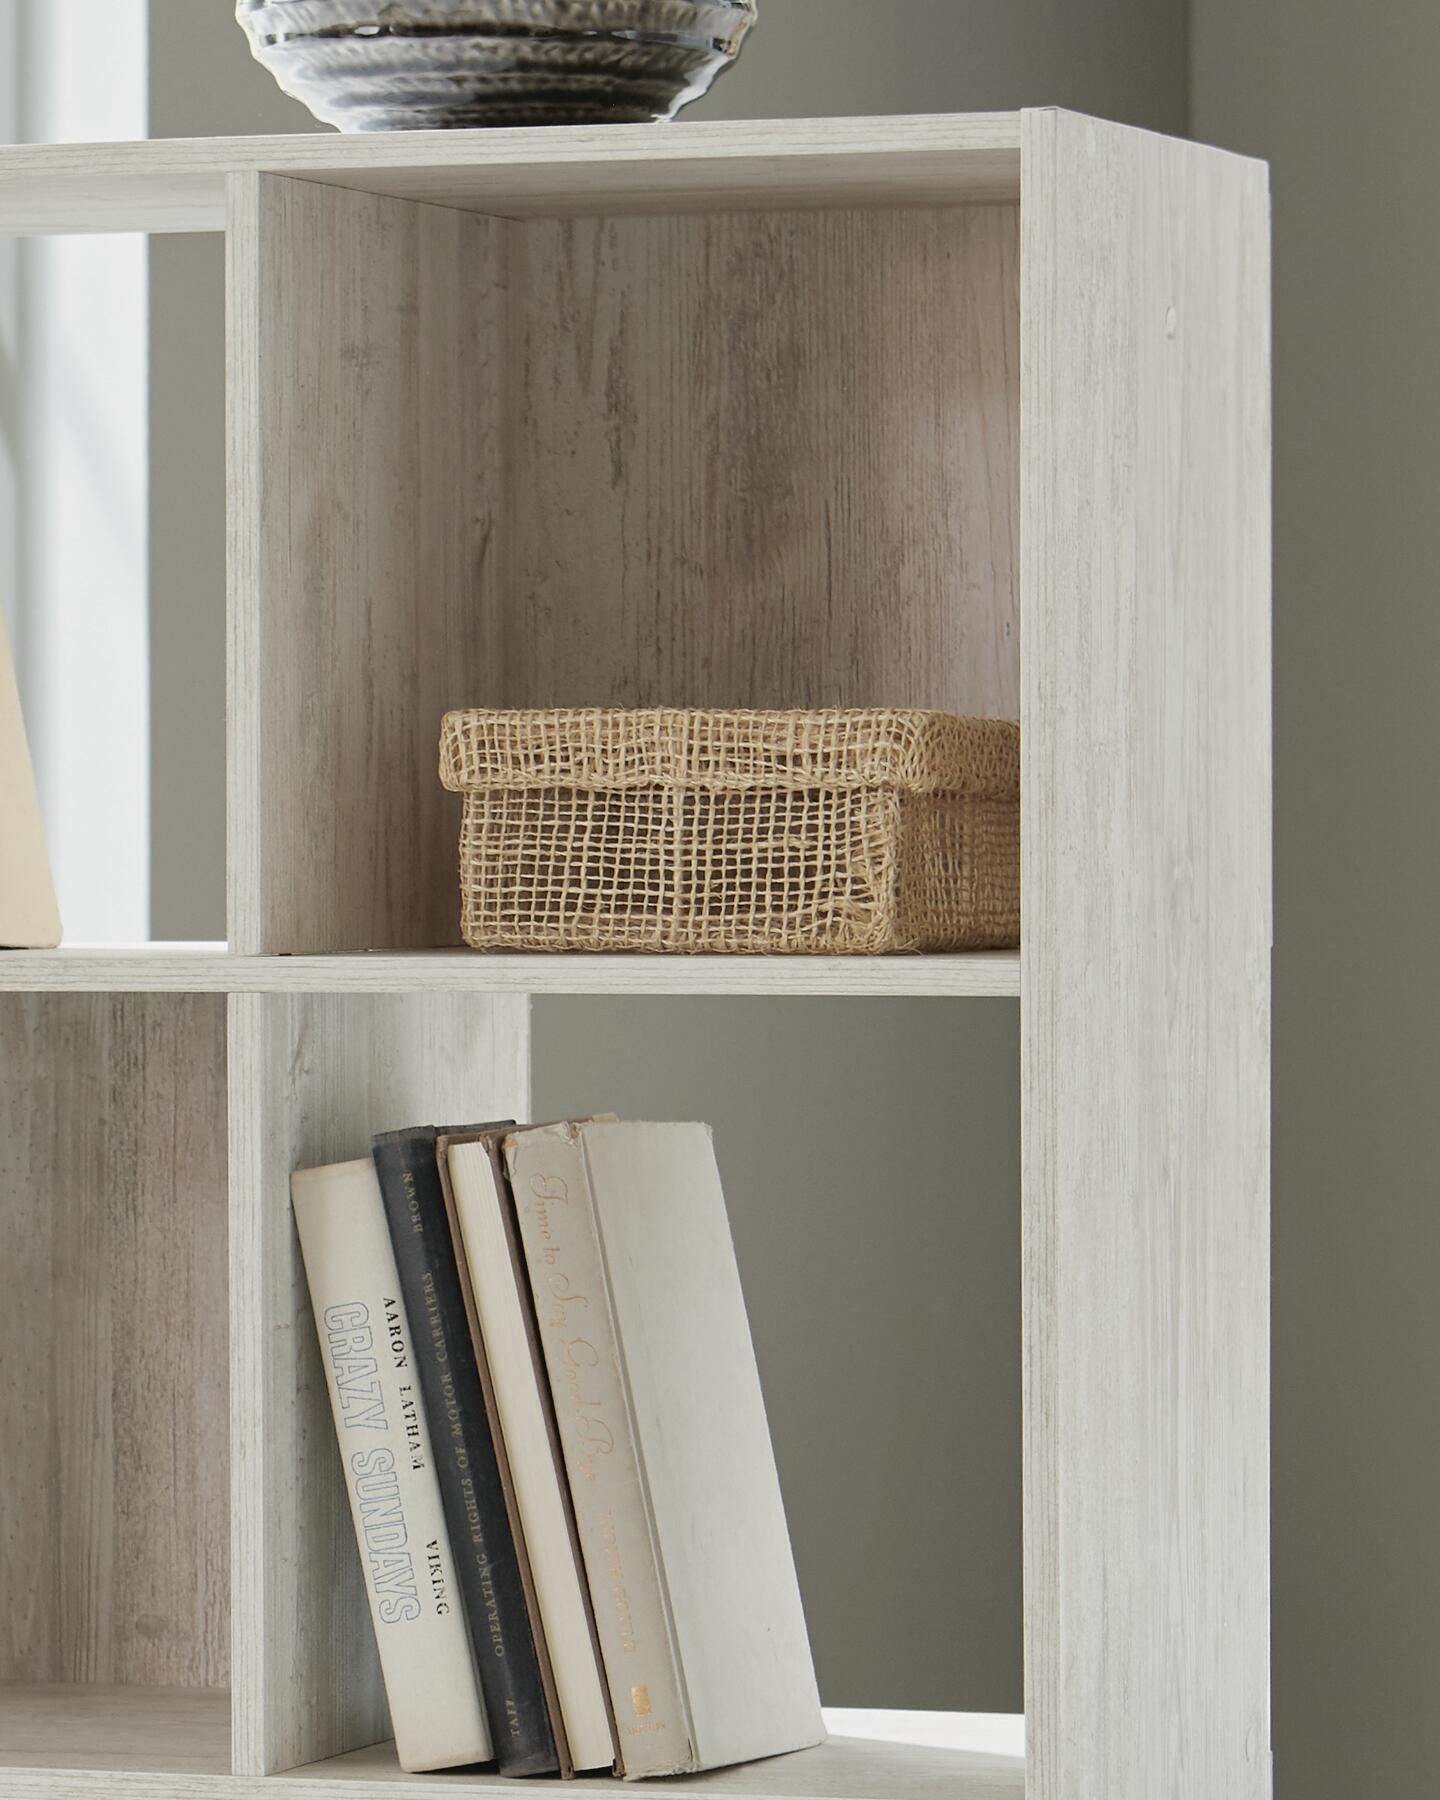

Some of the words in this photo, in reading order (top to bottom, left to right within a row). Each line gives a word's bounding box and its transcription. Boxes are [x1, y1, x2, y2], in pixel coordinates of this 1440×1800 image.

[402, 1171, 424, 1233] BROWN
[529, 1172, 569, 1240] Time
[421, 1271, 449, 1363] CARRIERS
[323, 1301, 389, 1431] CRAZY
[383, 1297, 408, 1369] AARON
[399, 1384, 425, 1471] LATHAM
[439, 1373, 464, 1440] MOTOR
[457, 1446, 471, 1469] OF
[351, 1447, 421, 1624] SUNDAYS
[462, 1477, 484, 1544] RIGHTS
[426, 1539, 450, 1616] VIKING
[476, 1553, 505, 1657] OPERATING
